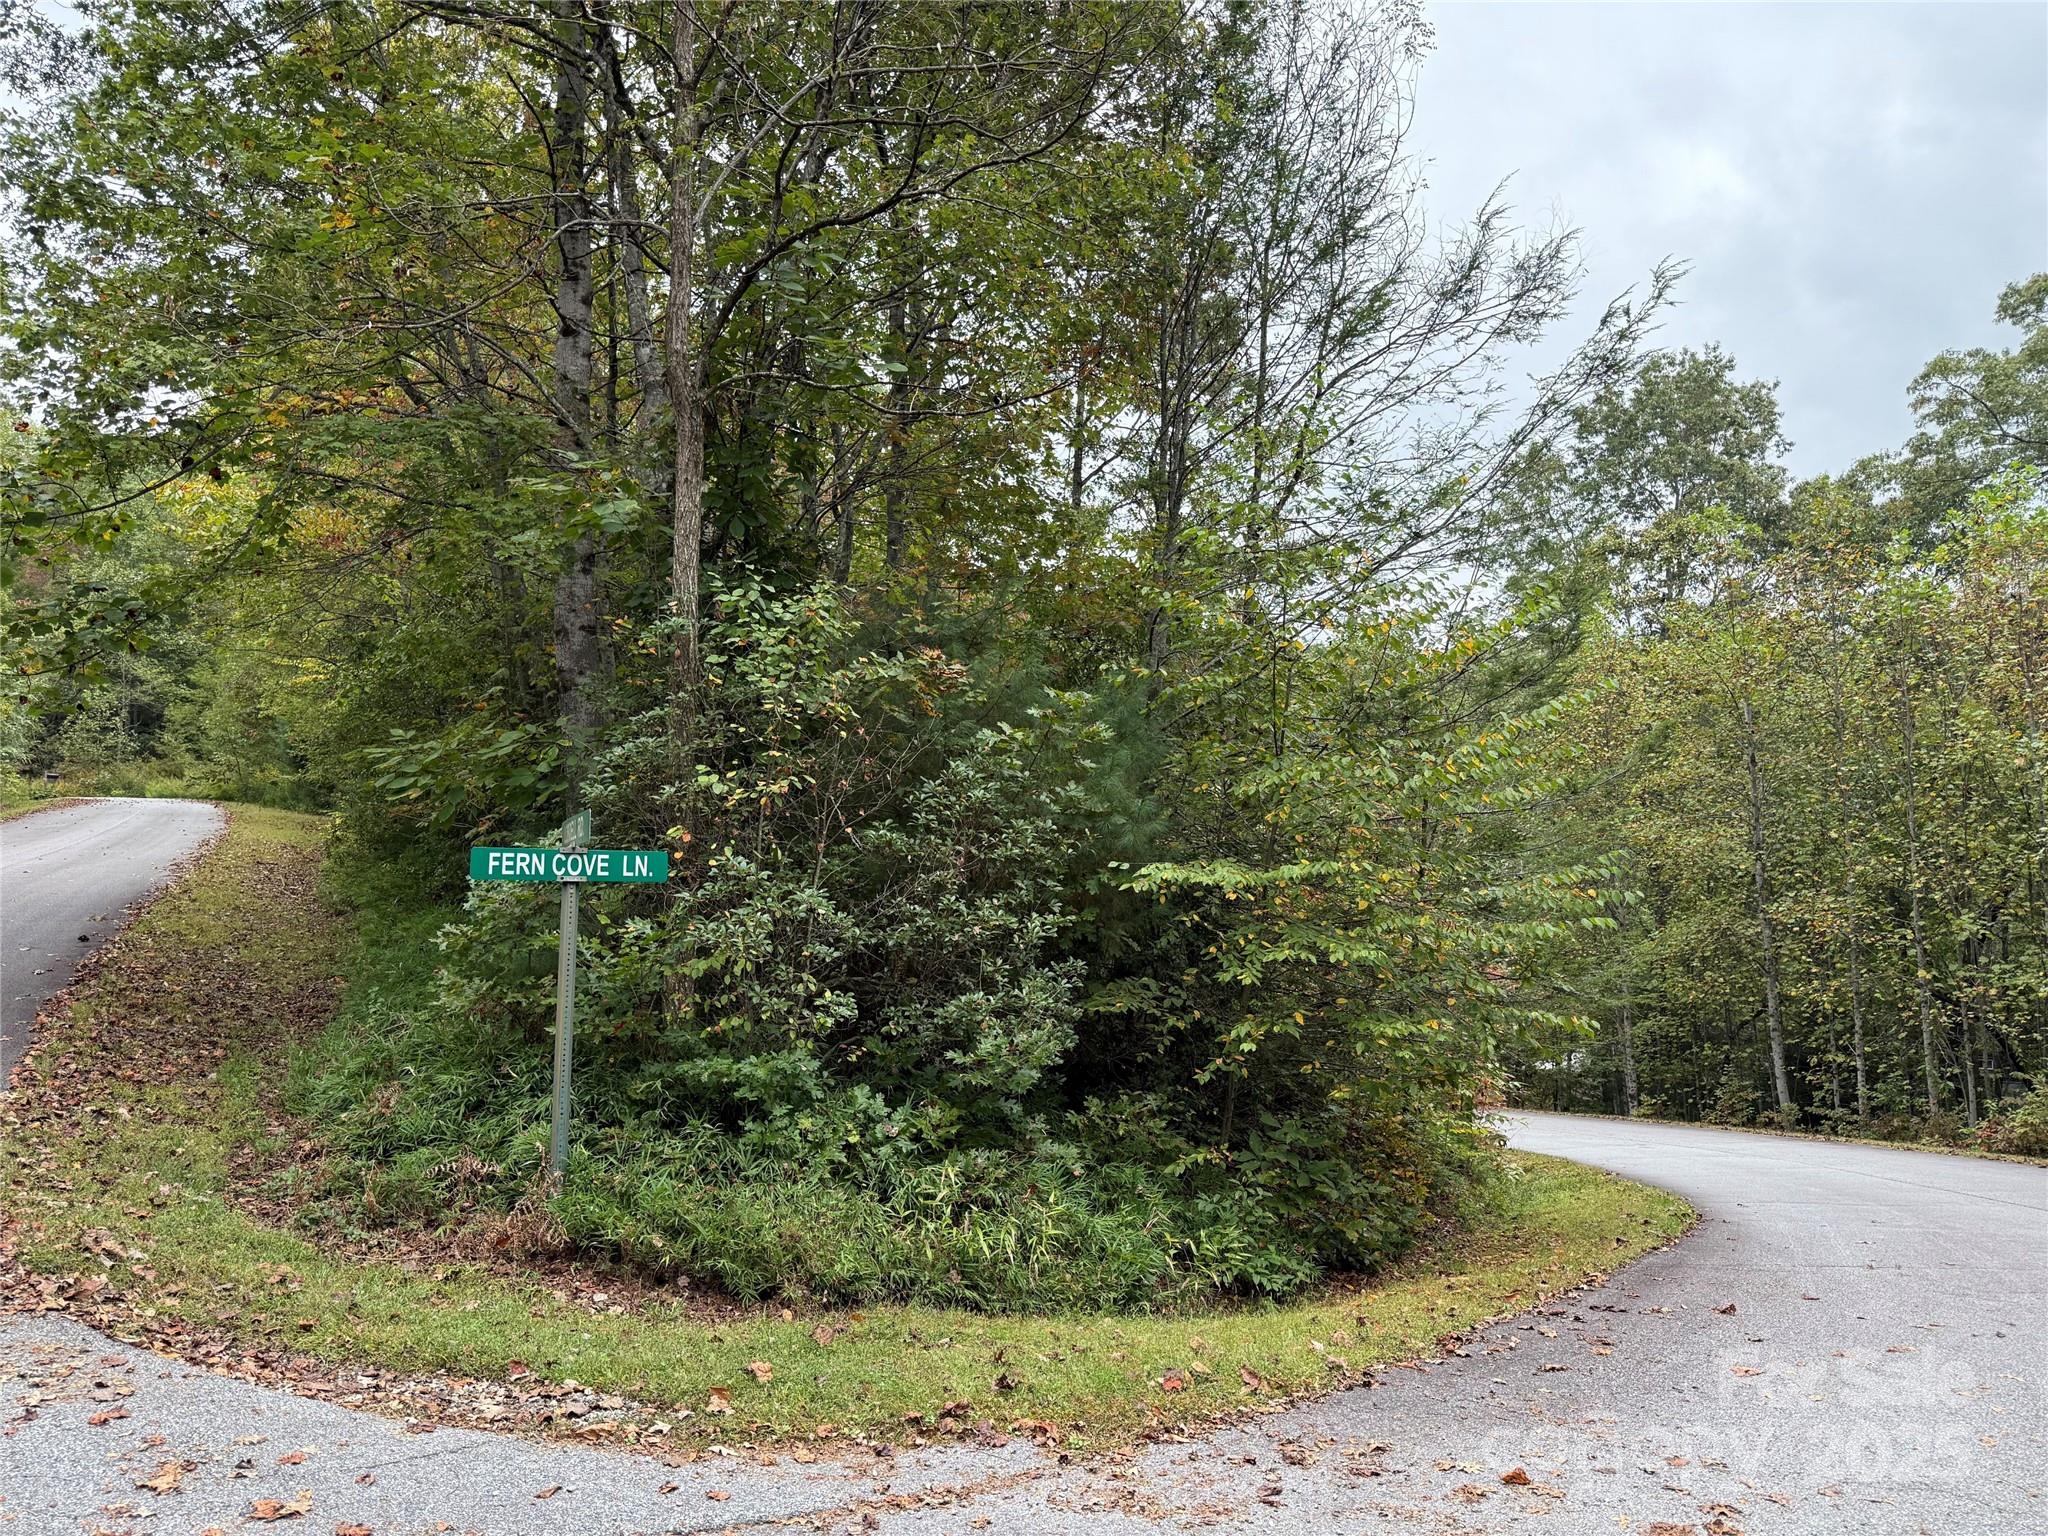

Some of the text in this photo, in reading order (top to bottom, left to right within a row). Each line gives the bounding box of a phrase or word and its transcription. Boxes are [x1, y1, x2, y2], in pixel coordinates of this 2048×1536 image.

[488, 852, 654, 877] FERN COVE LN.
